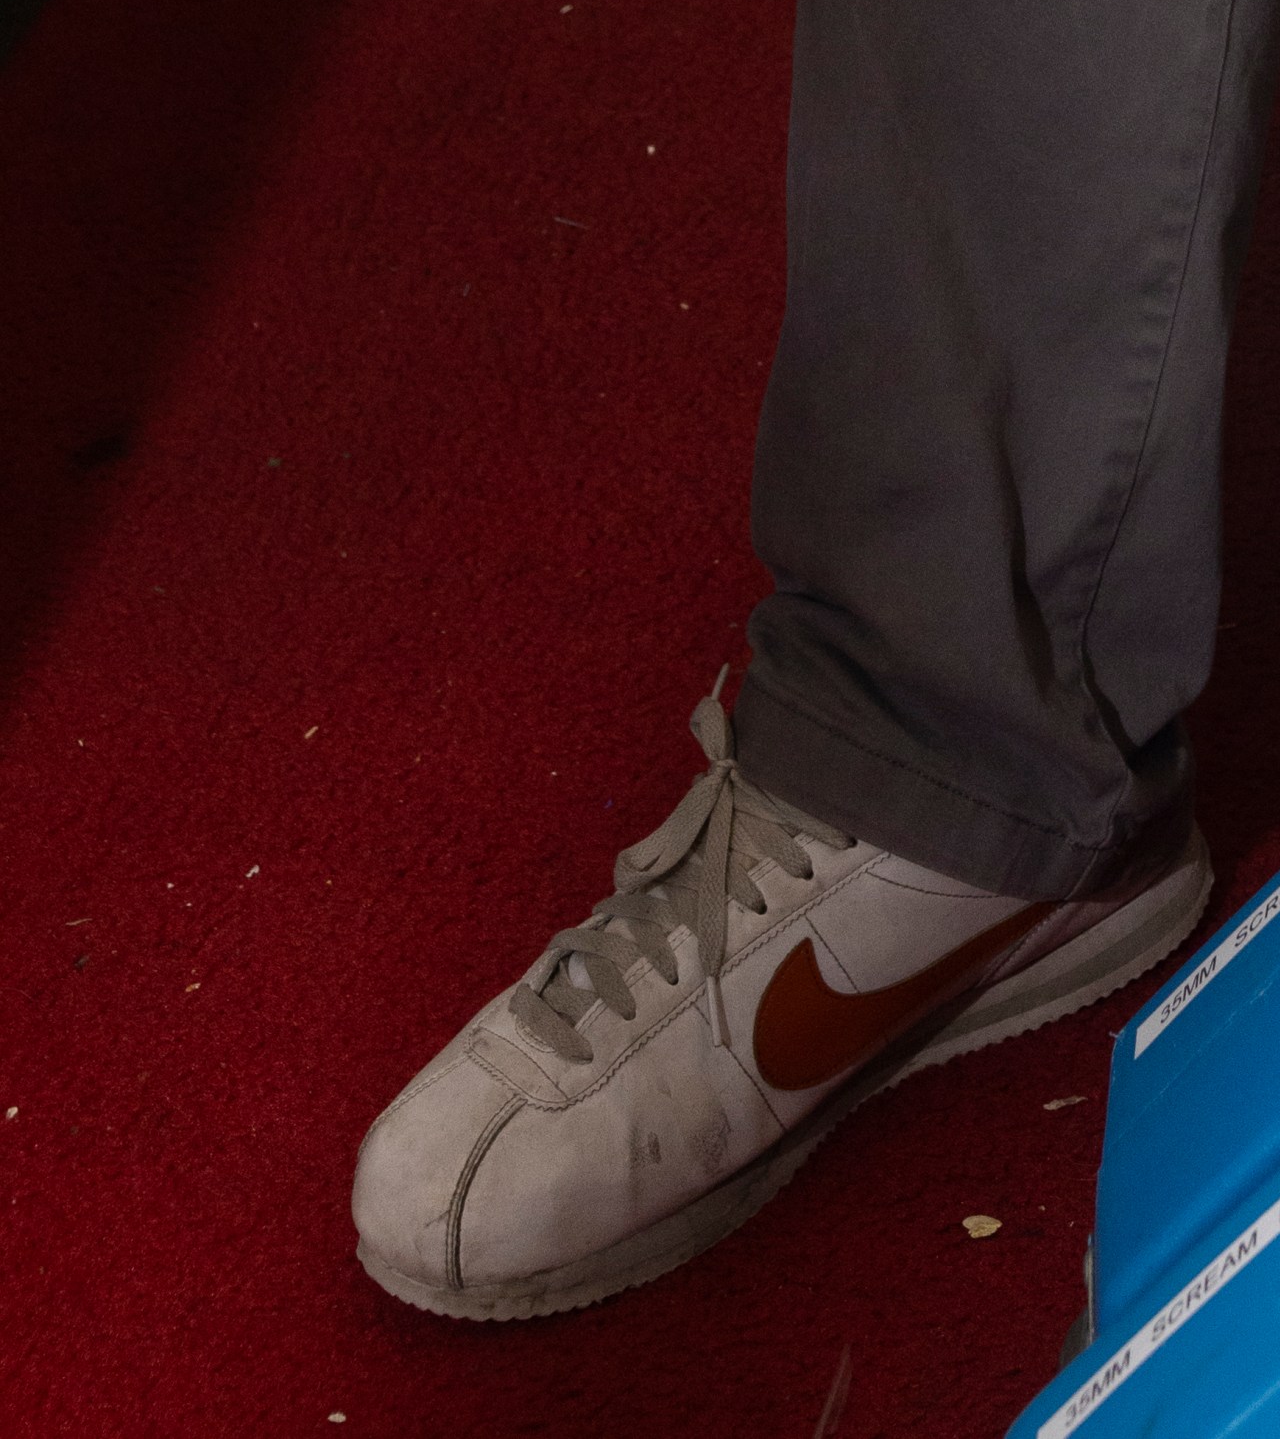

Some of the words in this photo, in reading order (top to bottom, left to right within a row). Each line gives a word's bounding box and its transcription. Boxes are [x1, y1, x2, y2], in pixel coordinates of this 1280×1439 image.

[1159, 957, 1218, 1026] 35MM
[1063, 1351, 1133, 1426] 35MM
[1151, 1231, 1259, 1343] SCREAM
